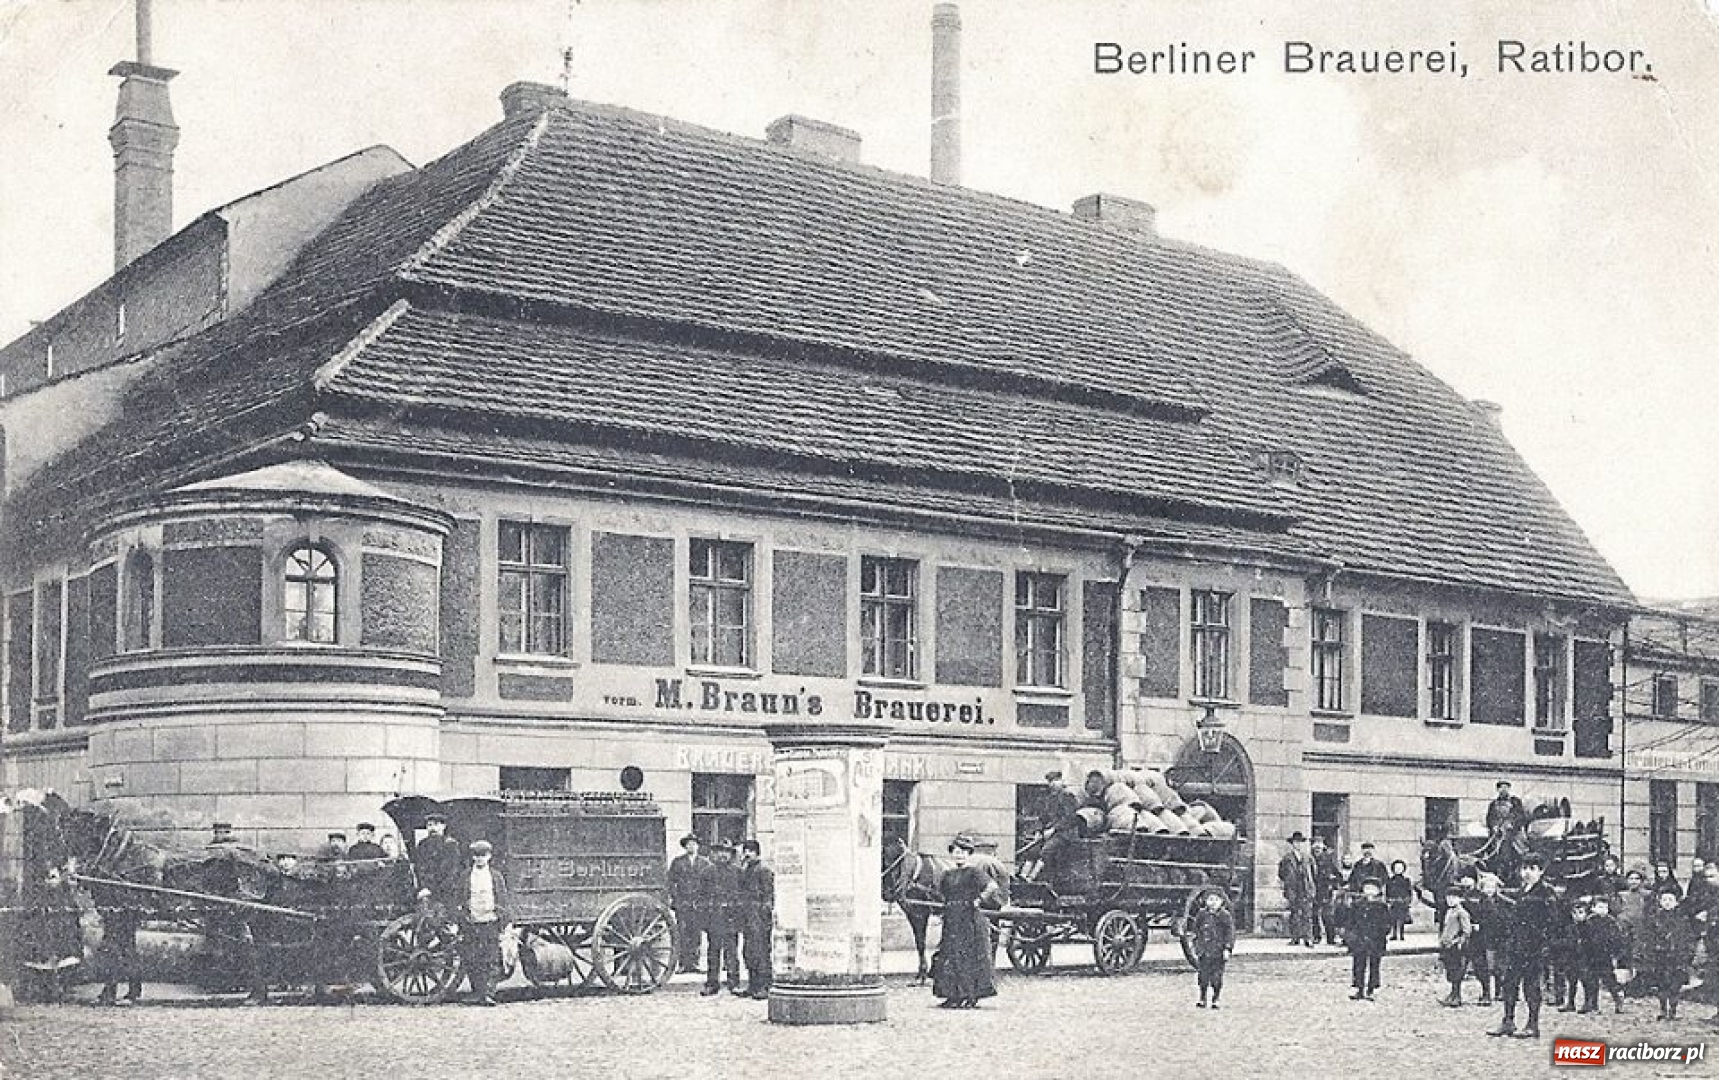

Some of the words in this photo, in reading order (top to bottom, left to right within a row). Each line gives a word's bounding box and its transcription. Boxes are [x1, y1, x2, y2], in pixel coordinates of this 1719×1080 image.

[603, 695, 643, 707] vorm.
[700, 680, 823, 716] Braun's
[853, 690, 996, 726] Brauerei.
